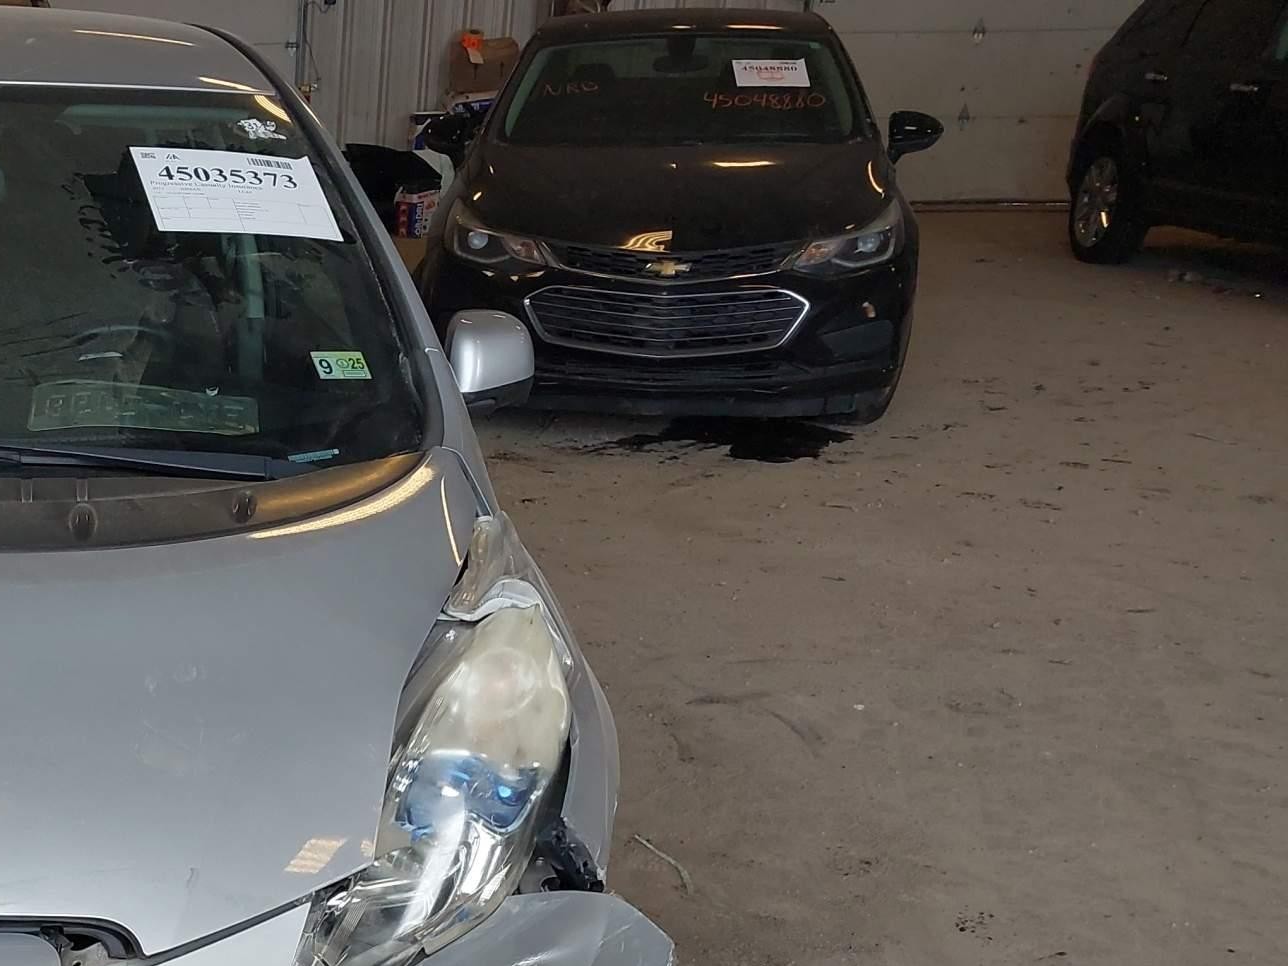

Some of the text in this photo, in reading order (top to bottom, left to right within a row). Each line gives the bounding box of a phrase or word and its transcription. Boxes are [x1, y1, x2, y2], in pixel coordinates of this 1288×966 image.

[158, 165, 298, 189] 45035373
[318, 357, 365, 375] 9 25
